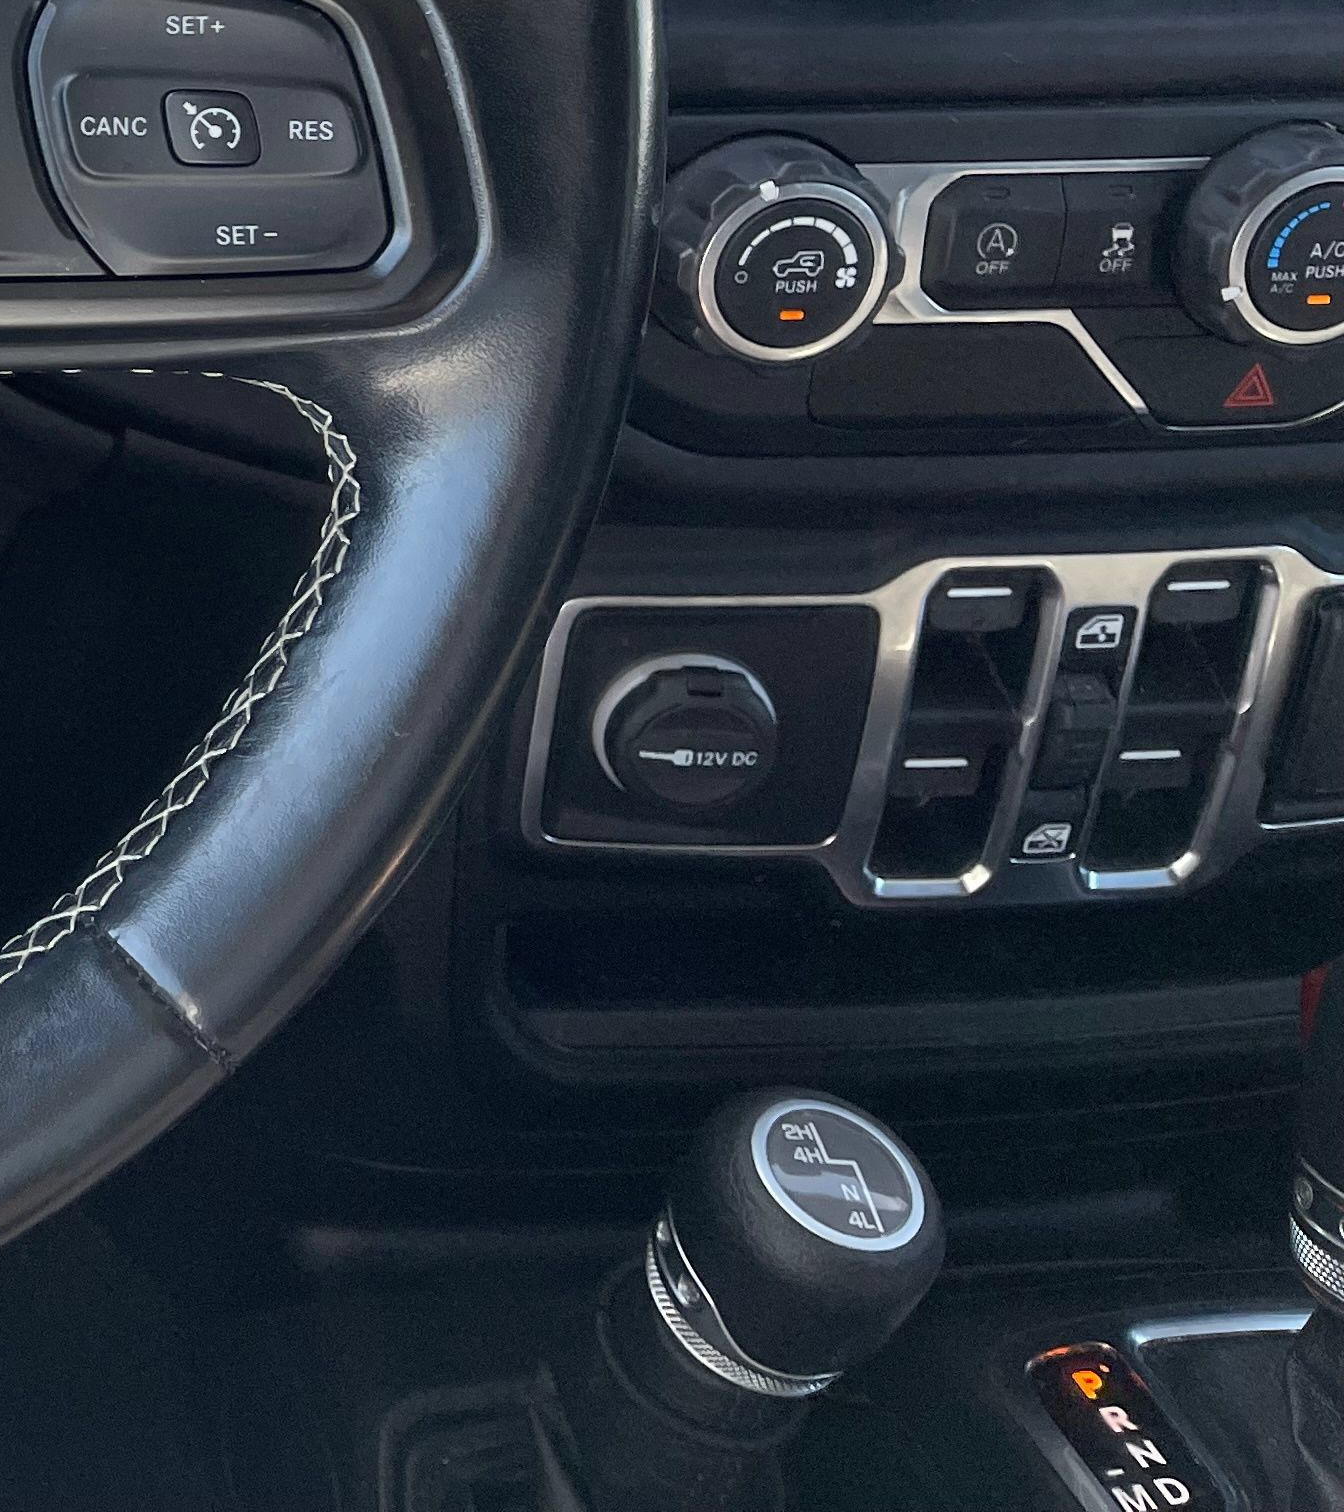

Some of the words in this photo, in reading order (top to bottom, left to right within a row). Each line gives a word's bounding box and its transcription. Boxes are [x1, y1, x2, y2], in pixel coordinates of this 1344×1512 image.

[79, 116, 147, 138] CANC
[288, 120, 334, 142] RES
[1310, 241, 1344, 259] A/C
[975, 260, 1010, 275] OFF
[1099, 258, 1133, 273] OFF
[1305, 265, 1344, 279] PUSH
[1271, 272, 1298, 281] MAX
[775, 280, 817, 293] PUSH
[1270, 284, 1294, 293] A/C
[696, 749, 727, 767] 12V
[731, 749, 758, 767] DC
[781, 1123, 813, 1140] 2H
[793, 1146, 824, 1164] 4H
[840, 1184, 860, 1201] N
[848, 1211, 876, 1229] 4L
[1072, 1370, 1102, 1400] P
[1099, 1406, 1138, 1433] R
[1126, 1439, 1167, 1468] N
[1153, 1478, 1190, 1505] D
